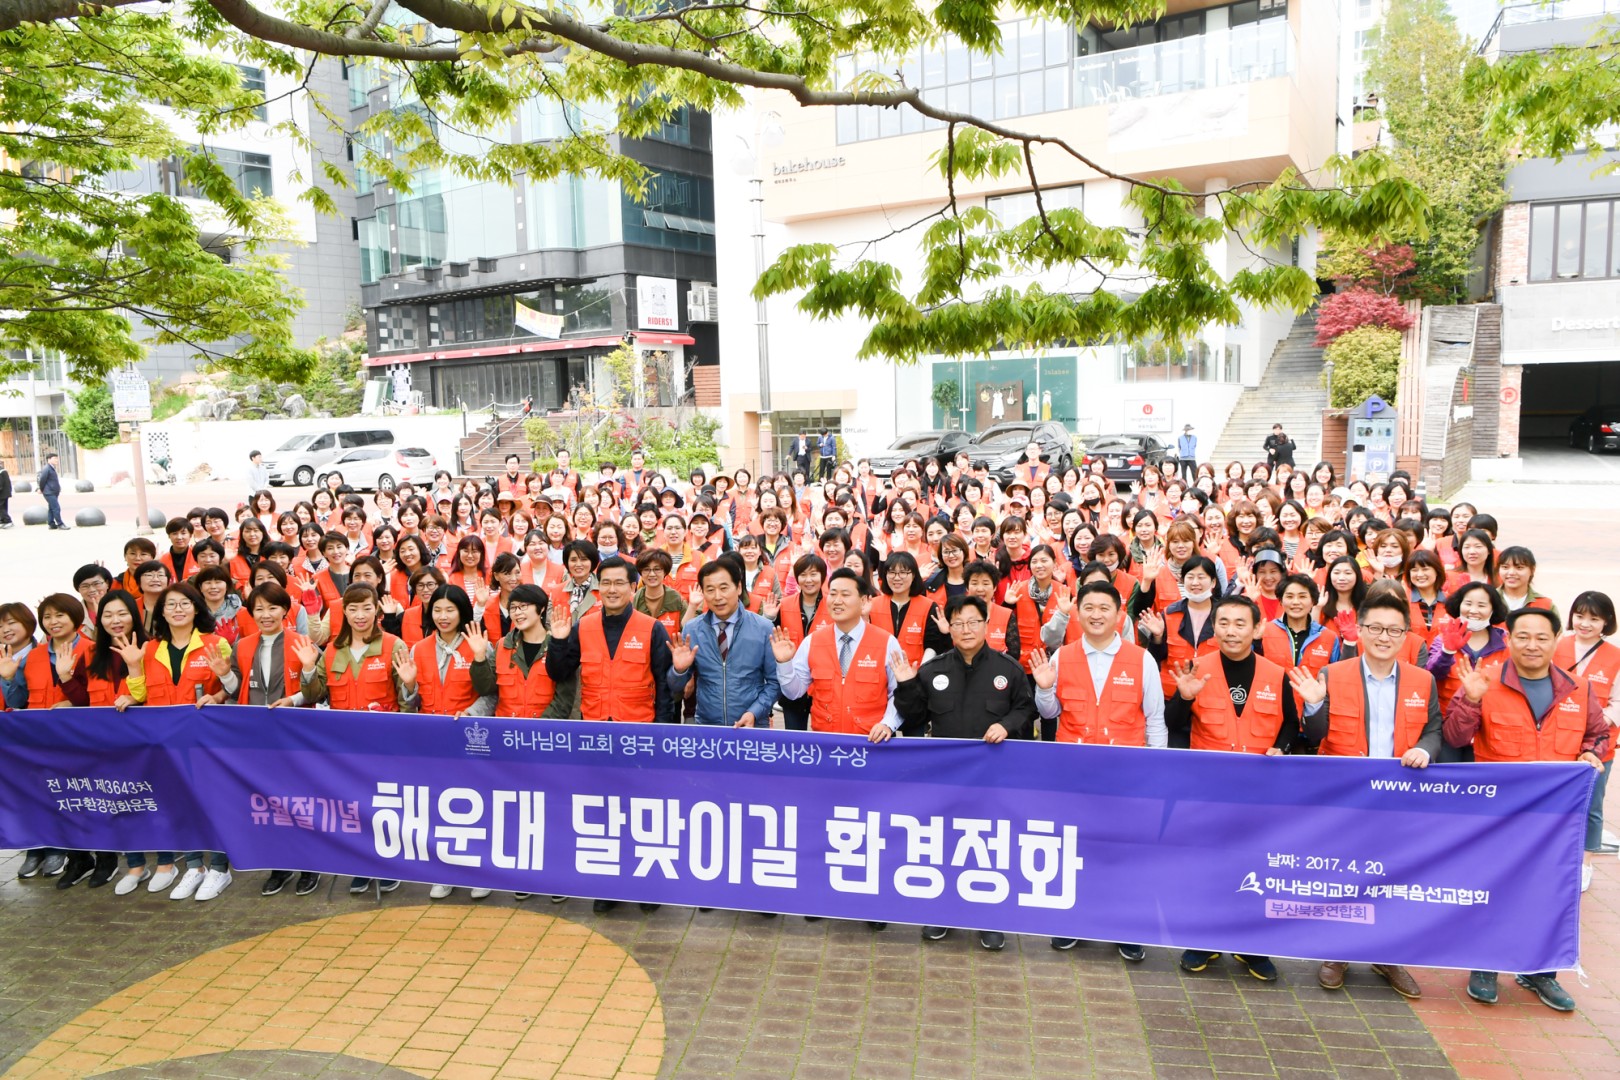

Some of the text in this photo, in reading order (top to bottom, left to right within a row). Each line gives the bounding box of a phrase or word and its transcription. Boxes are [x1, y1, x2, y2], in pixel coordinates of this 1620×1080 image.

[772, 155, 846, 176] bakehouse
[1551, 316, 1620, 331] Dessert
[1365, 397, 1386, 420] P
[502, 729, 872, 768] 하나님의 교회 영국 여왕상(자원봉사상) 수상
[46, 777, 154, 795] 전 세계 제3643차
[1370, 779, 1497, 798] www.watv.org
[56, 797, 158, 815] 지구환경정화운동
[250, 782, 1084, 910] 유월절기념 해운대 달맞이길 환경정화
[1267, 852, 1386, 876] 날짜: 2017. 4. 20.
[1265, 875, 1490, 905] 하나님의교회 세계복음선교협회
[1270, 902, 1367, 920] 부산북동연합회
